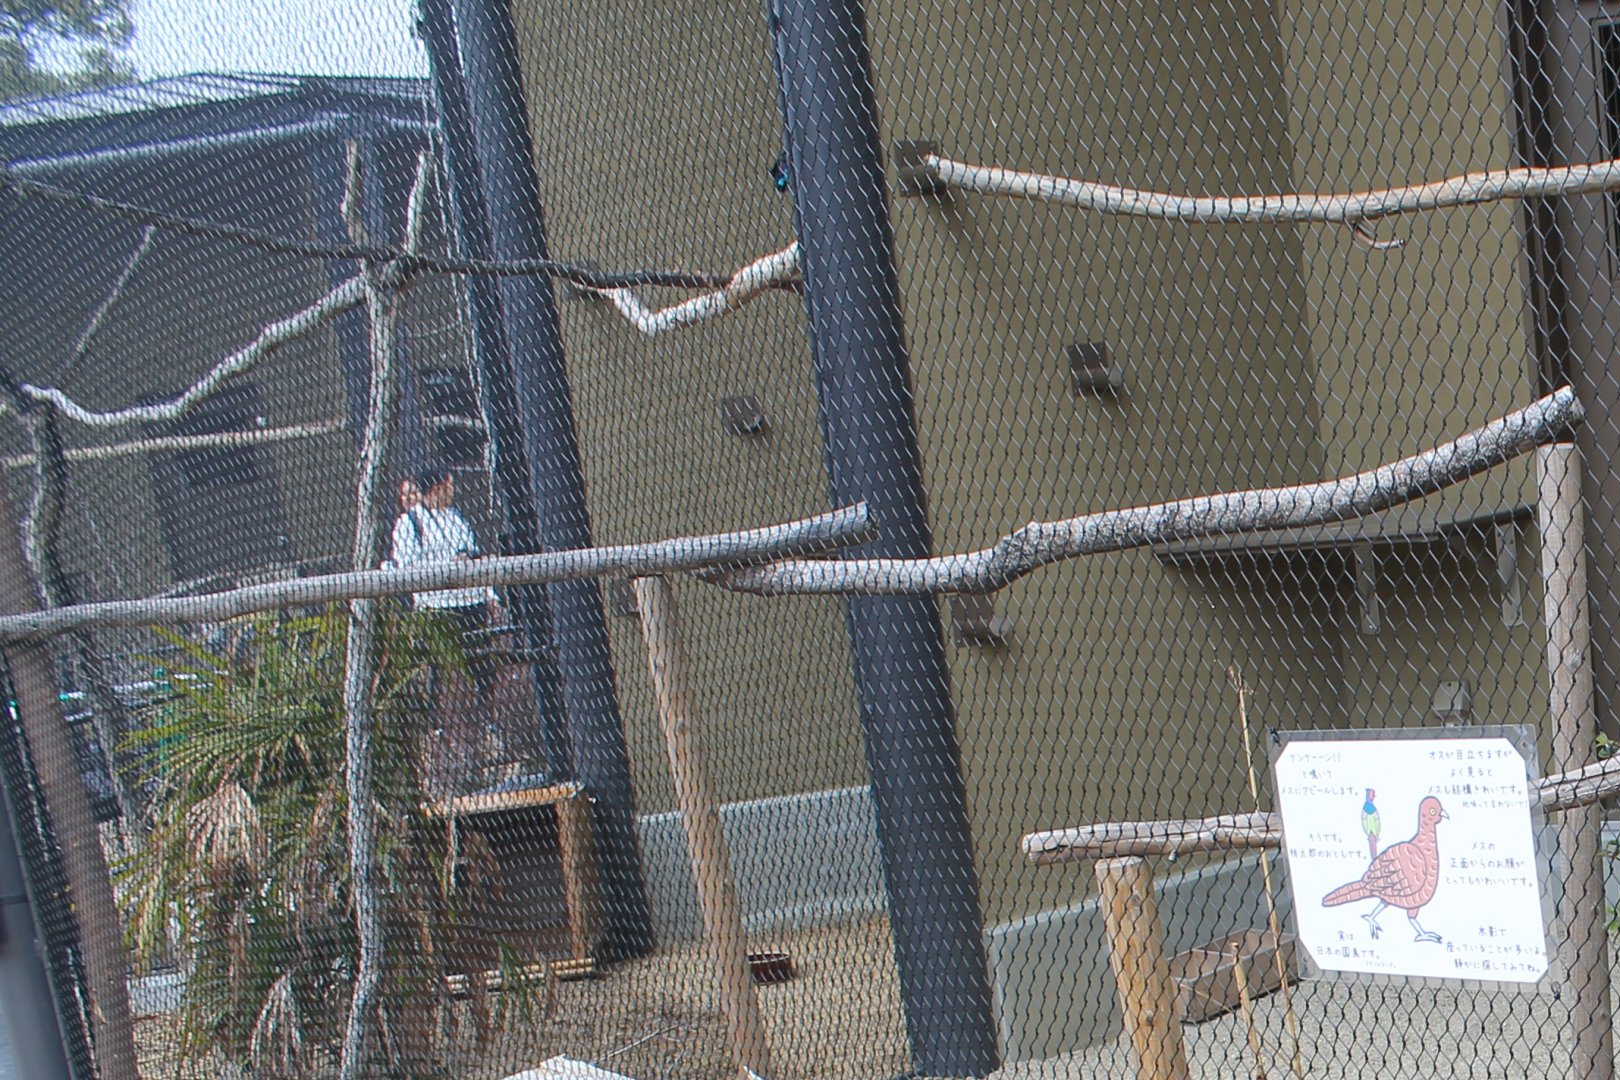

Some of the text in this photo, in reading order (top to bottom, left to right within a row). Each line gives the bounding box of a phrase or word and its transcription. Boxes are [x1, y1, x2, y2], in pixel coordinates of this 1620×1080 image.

[1428, 748, 1513, 761] オスが目立ちますが
[1450, 766, 1493, 778] よく見ると
[1281, 785, 1359, 797] メスにアピールします。
[1428, 783, 1522, 796] メスも結構きれいです。
[1471, 840, 1496, 851] メスの
[1290, 847, 1368, 861] 桃太郎のおともです。
[1449, 857, 1525, 870] 正面からのお顔が
[1446, 876, 1533, 888] とってもかわいいです。
[1336, 930, 1355, 942] 実は
[1316, 945, 1381, 960] 日本の国鳥です。
[1454, 957, 1541, 974] 静かに探してみてね。
